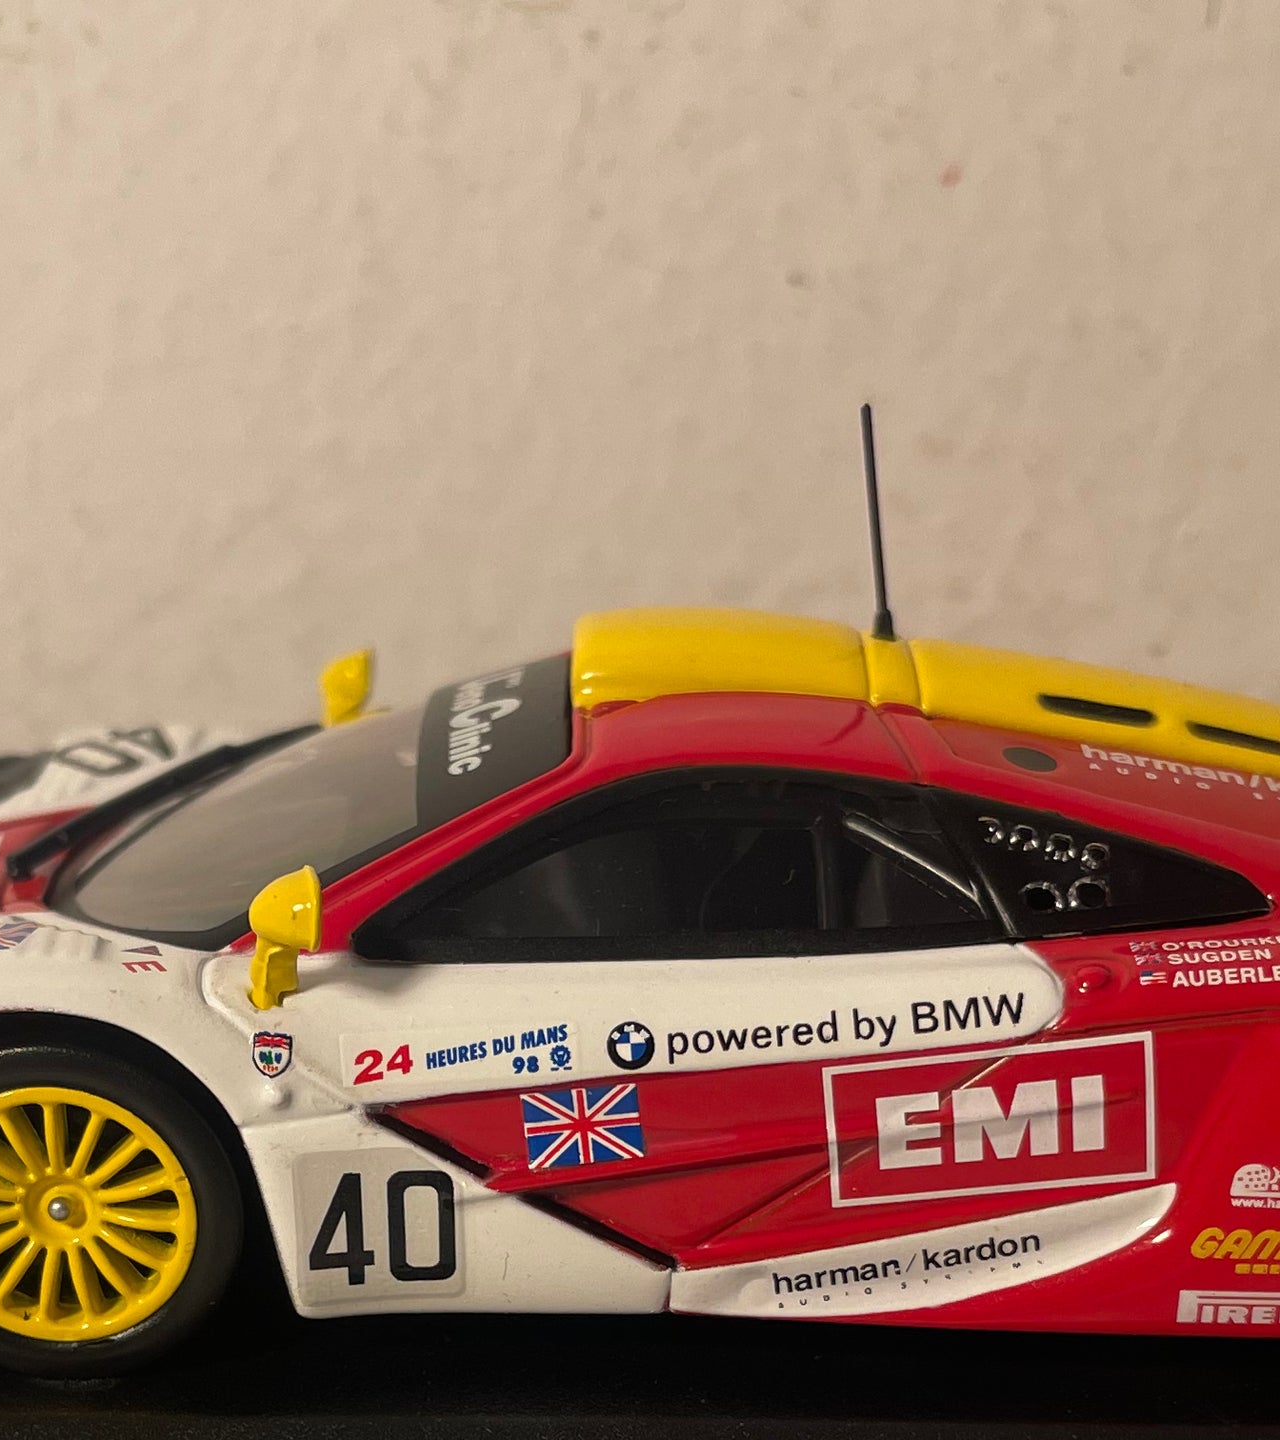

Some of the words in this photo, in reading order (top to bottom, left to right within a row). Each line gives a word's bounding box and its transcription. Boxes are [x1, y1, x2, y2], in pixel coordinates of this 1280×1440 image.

[1167, 949, 1272, 966] SUGDEN
[353, 1043, 413, 1086] 24
[425, 1041, 487, 1070] HEURES
[492, 1034, 516, 1056] DU
[521, 1023, 568, 1050] MANS
[666, 1010, 840, 1064] powered
[852, 1007, 897, 1047] by
[910, 992, 1025, 1035] BMW
[512, 1055, 540, 1075] 98
[874, 1074, 1109, 1171] EMI
[306, 1168, 456, 1287] 40
[771, 1233, 1042, 1295] harman/kardon
